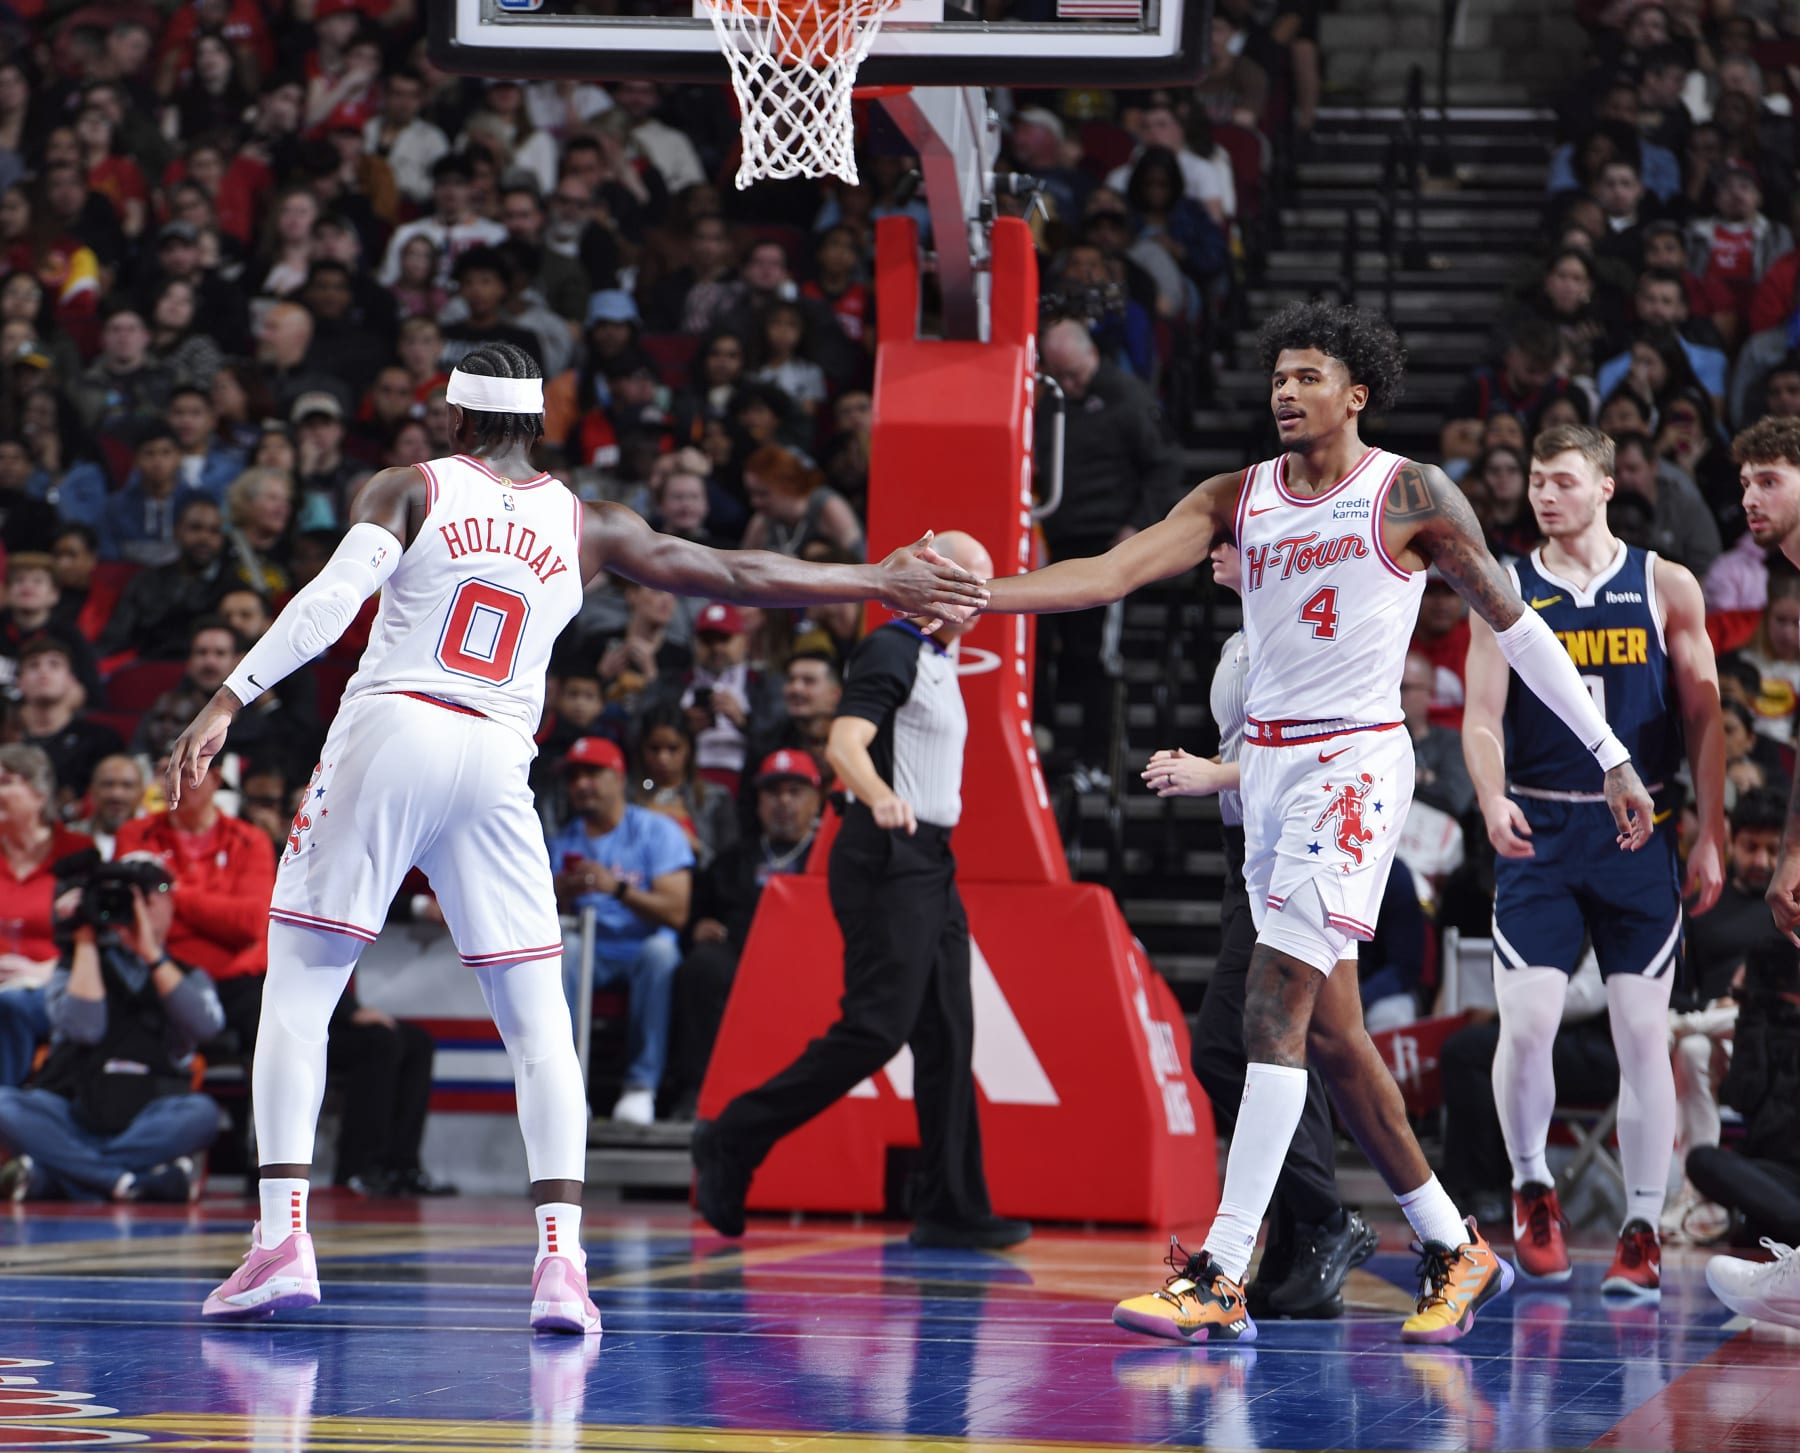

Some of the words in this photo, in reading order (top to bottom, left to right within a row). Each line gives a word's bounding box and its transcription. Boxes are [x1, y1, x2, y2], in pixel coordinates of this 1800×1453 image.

[1332, 509, 1369, 519] karma
[1335, 497, 1371, 509] credit
[439, 517, 567, 584] HOLIDAY
[1246, 530, 1369, 592] H-Town
[434, 576, 531, 687] 0
[1298, 585, 1340, 641] 4
[1553, 627, 1648, 667] NVER
